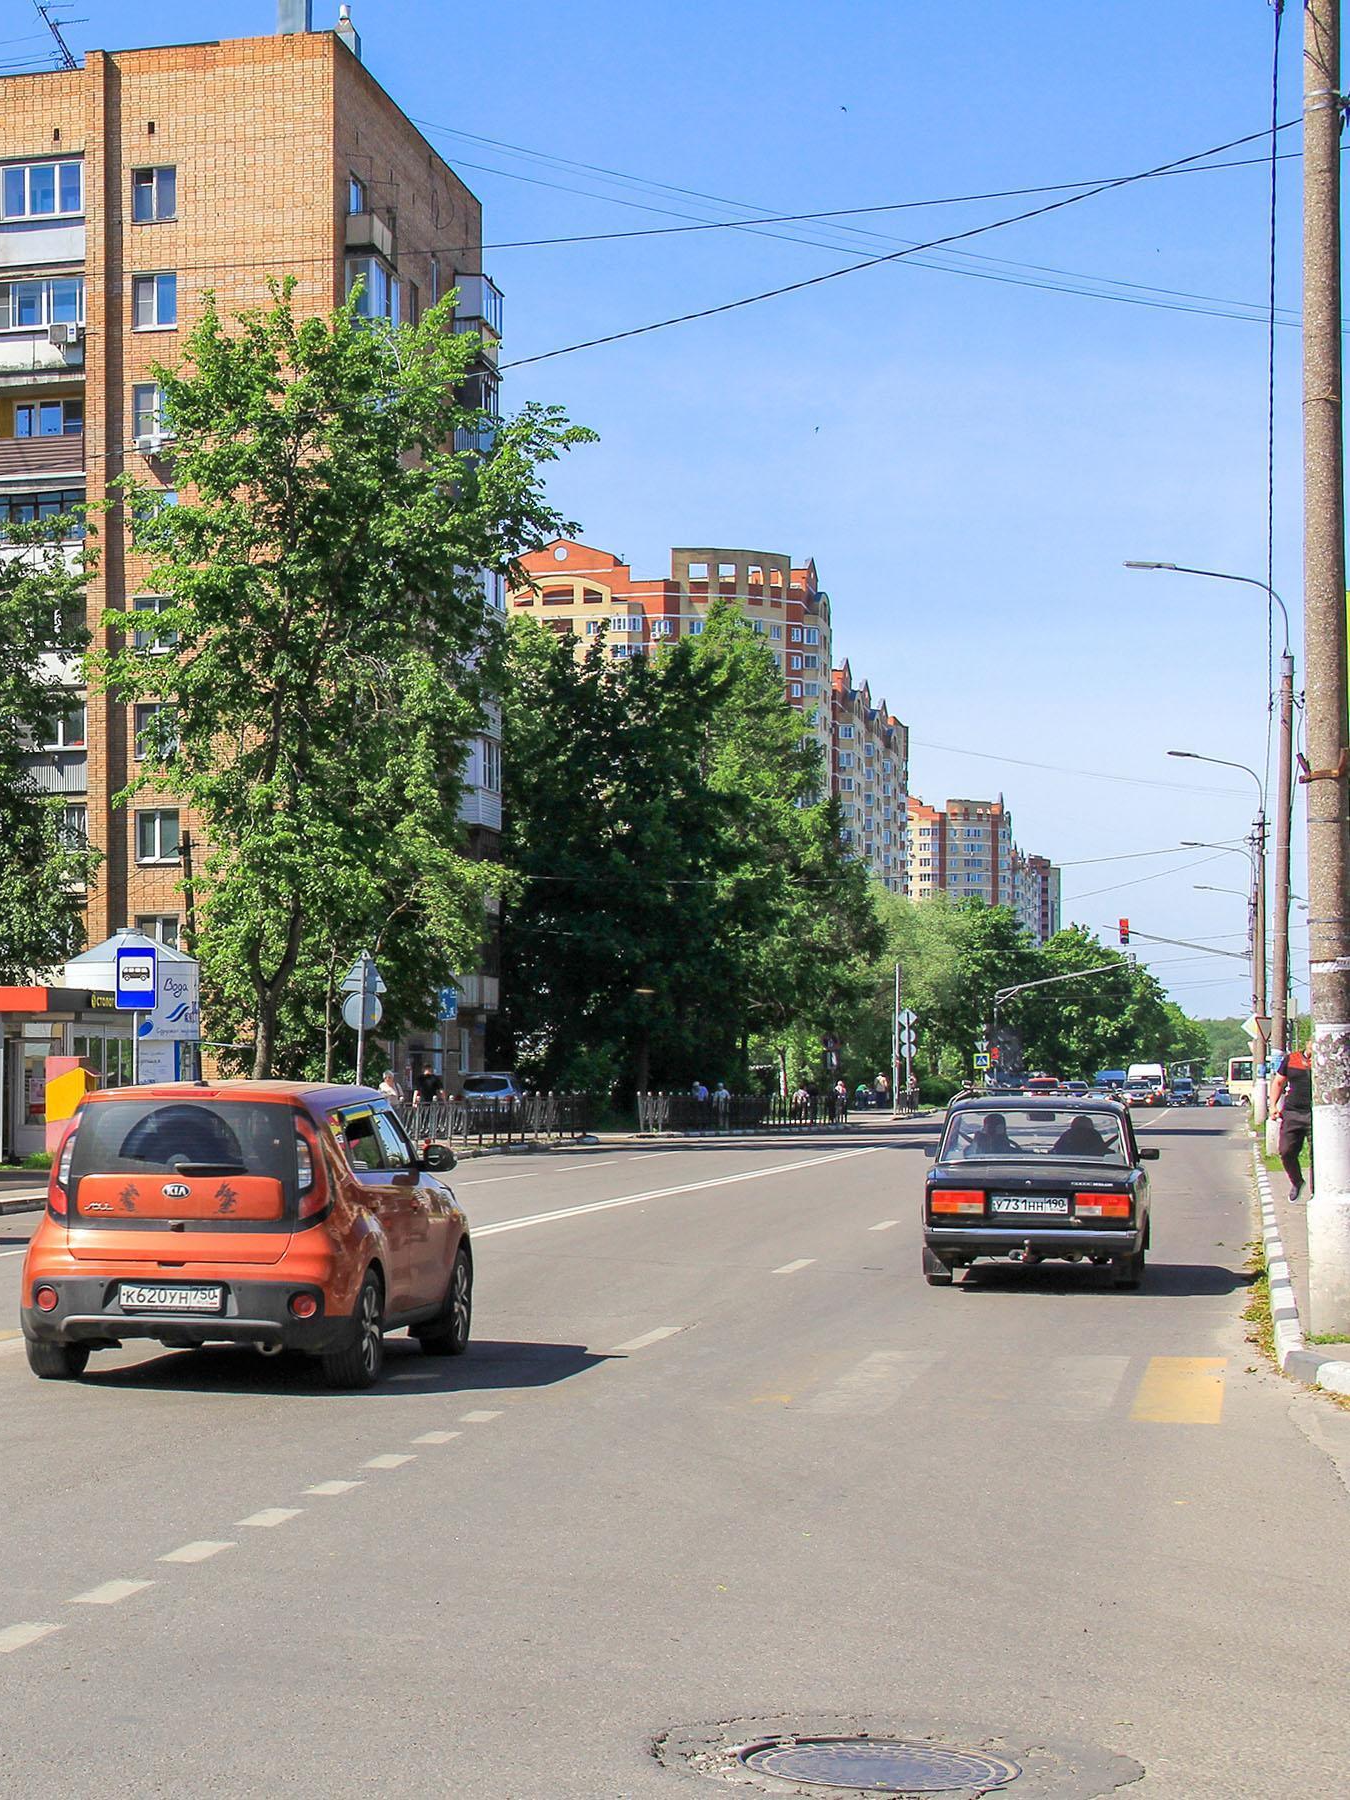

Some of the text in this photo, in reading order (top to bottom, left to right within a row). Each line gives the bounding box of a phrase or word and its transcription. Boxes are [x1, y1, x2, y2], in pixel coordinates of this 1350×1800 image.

[163, 977, 189, 998] Вода
[165, 1185, 187, 1195] KIA
[1047, 1198, 1065, 1209] 190
[125, 1287, 216, 1304] К620УН 750
